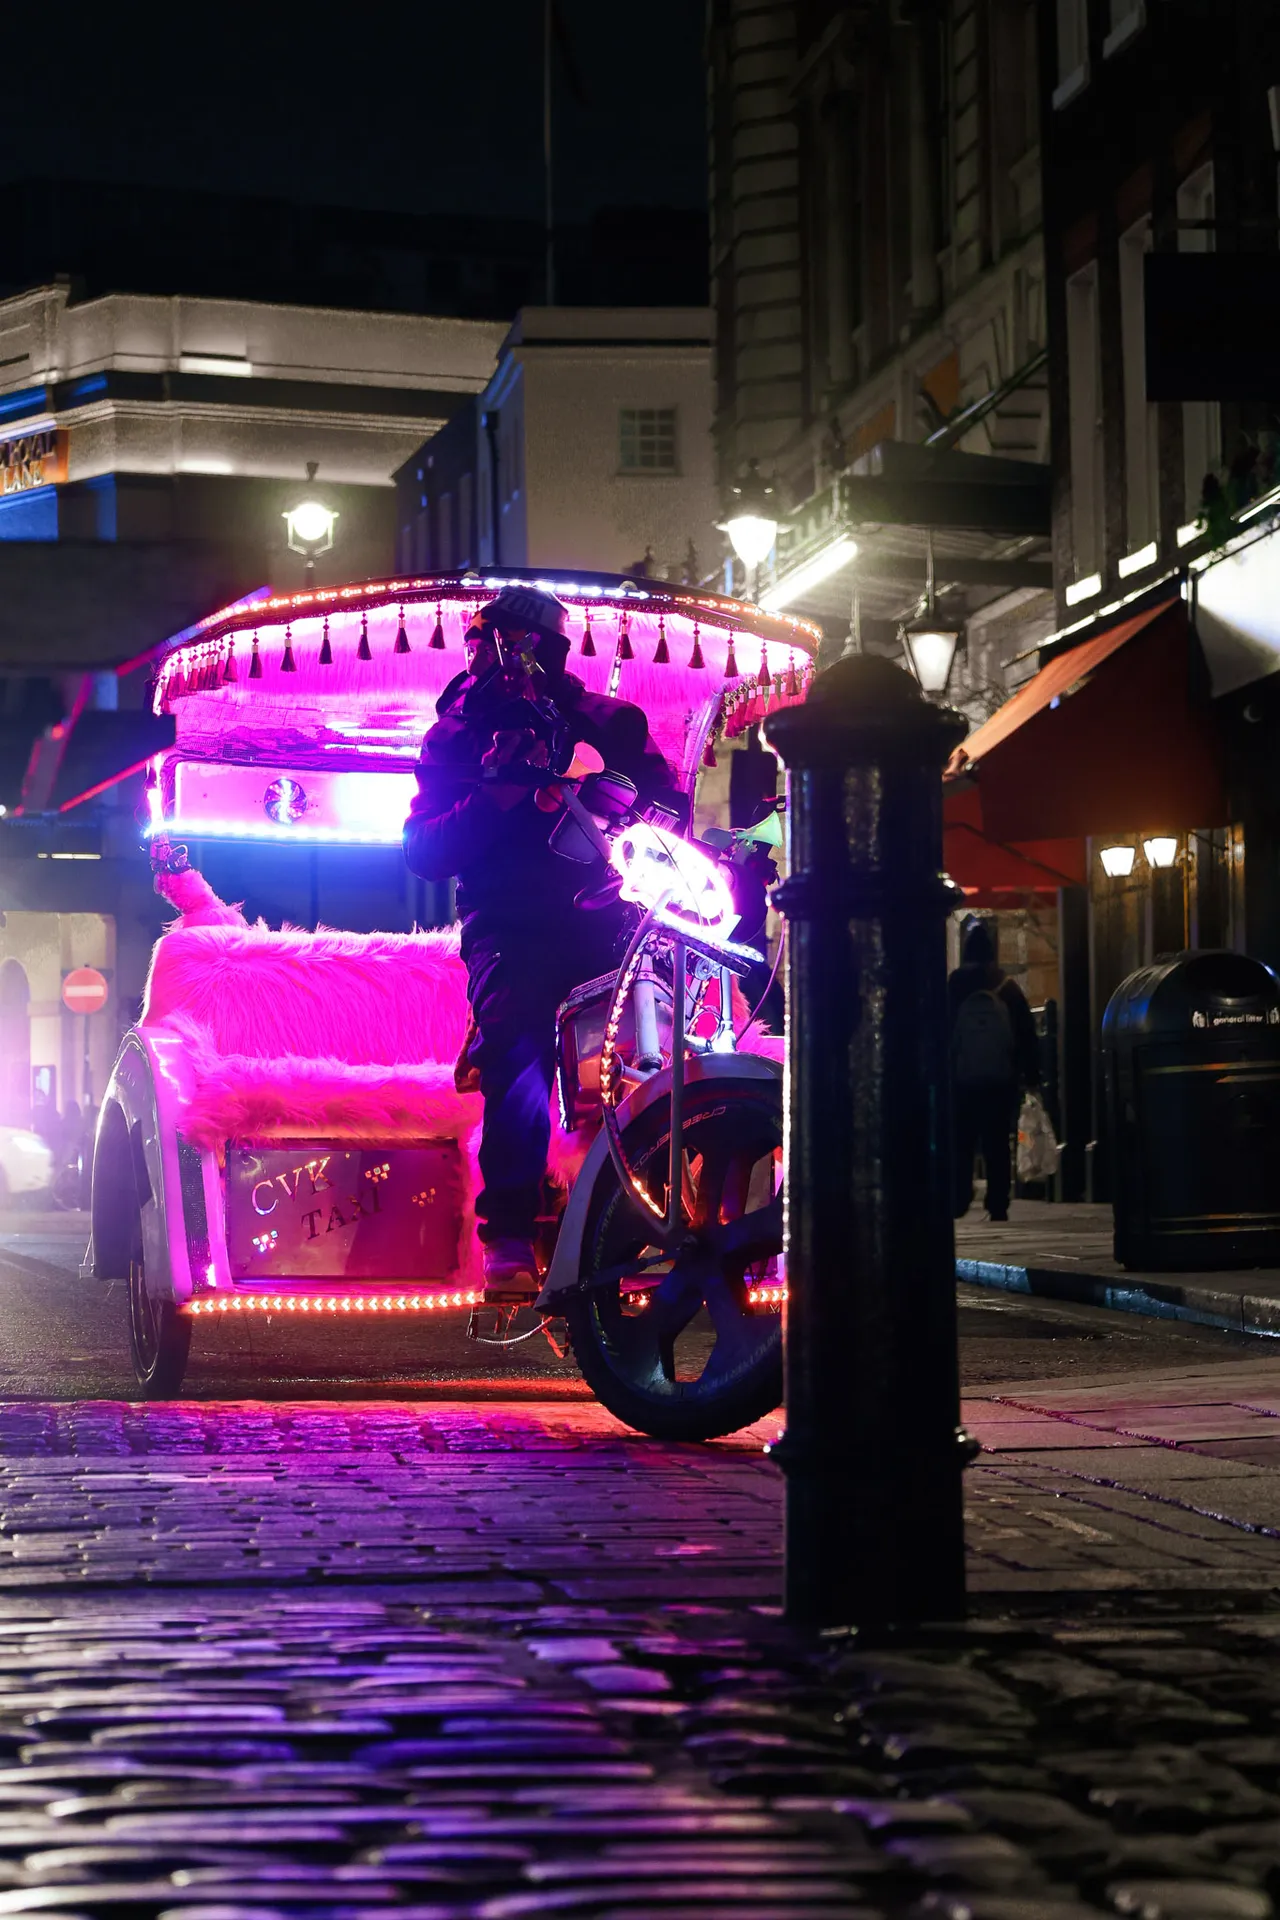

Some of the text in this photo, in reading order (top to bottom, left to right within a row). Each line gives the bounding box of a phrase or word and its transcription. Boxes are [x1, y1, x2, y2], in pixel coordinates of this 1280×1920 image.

[4, 460, 43, 493] LANE
[1213, 1014, 1263, 1026] general litter
[252, 1156, 335, 1215] CVK
[301, 1185, 384, 1240] TAXI
